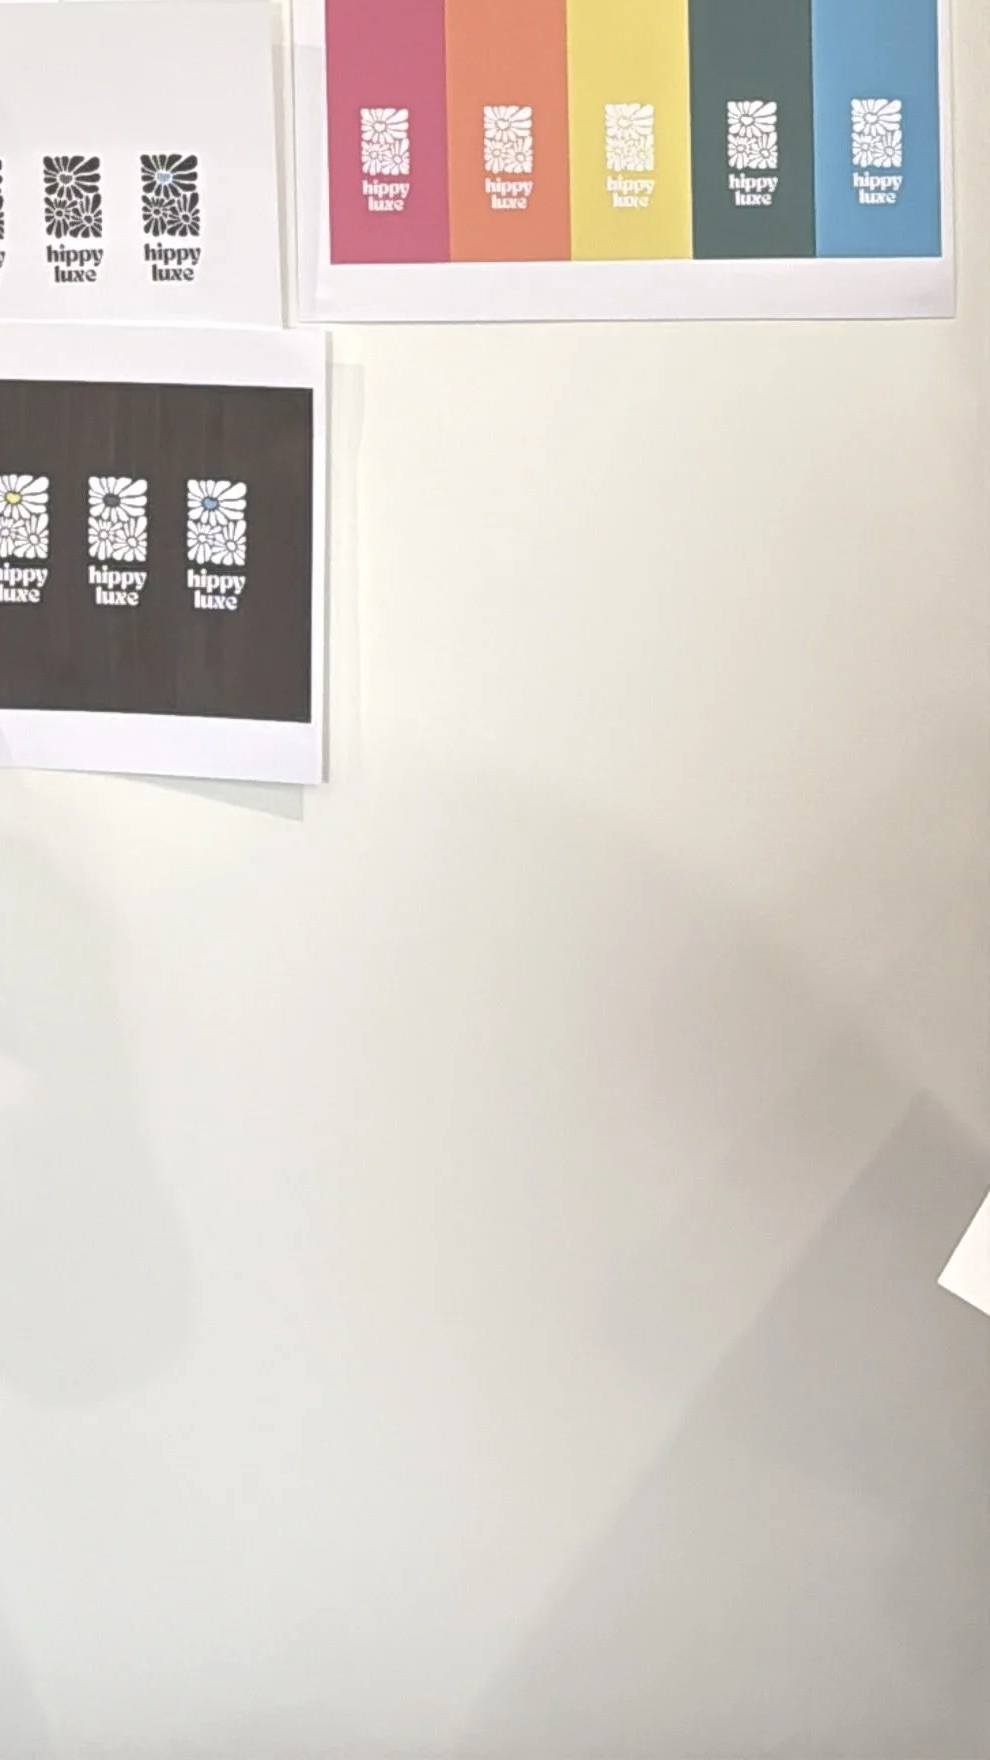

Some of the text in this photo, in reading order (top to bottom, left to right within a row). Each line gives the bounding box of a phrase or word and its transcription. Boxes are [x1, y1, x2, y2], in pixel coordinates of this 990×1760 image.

[363, 179, 409, 199] hippy
[485, 177, 533, 196] hippy
[607, 175, 654, 194] hippy
[729, 174, 777, 192] hippy
[853, 173, 902, 191] hippy
[368, 195, 404, 211] luxe
[492, 194, 526, 209] luxe
[613, 192, 650, 207] luxe
[735, 191, 771, 205] luxe
[859, 190, 896, 204] luxe
[47, 245, 103, 266] hippy
[144, 243, 200, 265] hippy
[55, 266, 96, 282] luxe
[152, 265, 194, 281] luxe
[89, 566, 147, 588] hippy
[188, 570, 245, 592] hippy
[96, 588, 138, 605] luxe
[195, 591, 237, 609] luxe
